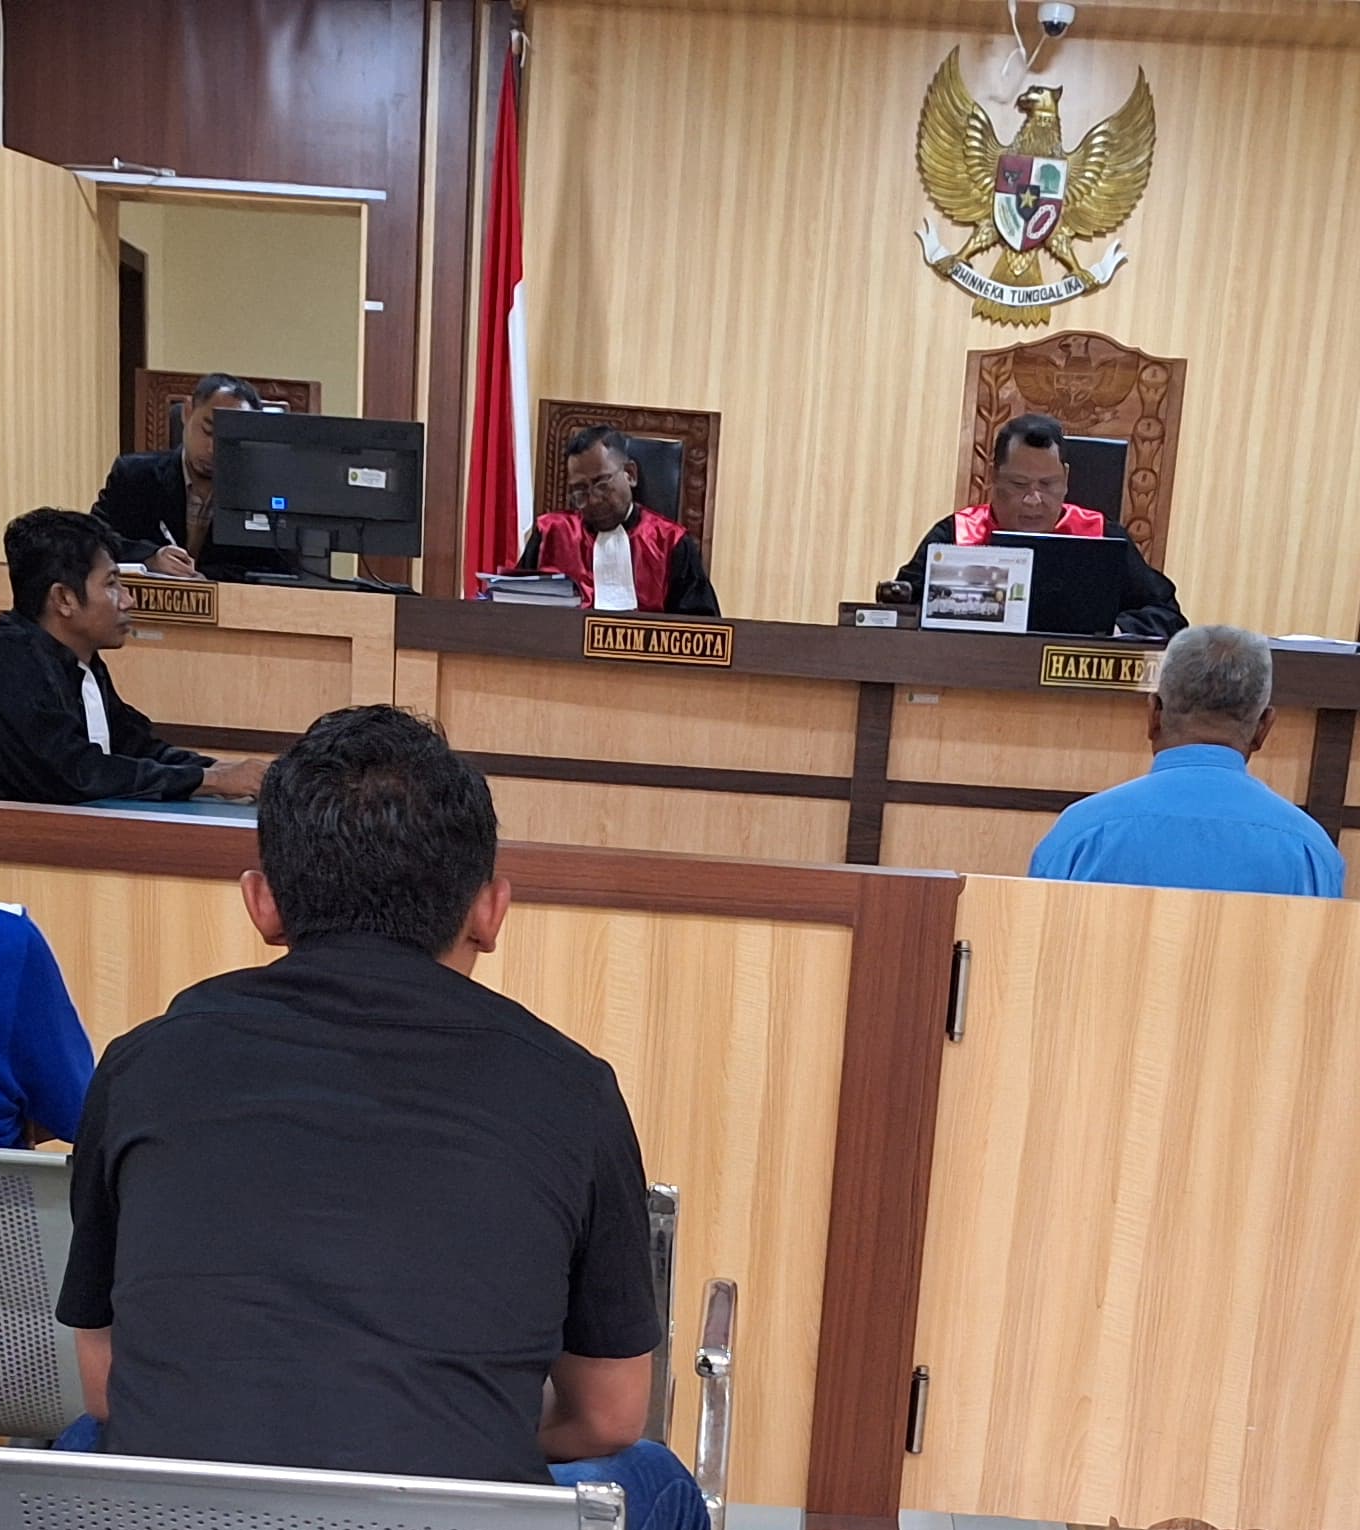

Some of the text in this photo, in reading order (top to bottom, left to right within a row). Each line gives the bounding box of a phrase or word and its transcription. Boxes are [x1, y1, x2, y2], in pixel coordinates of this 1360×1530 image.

[952, 266, 1083, 303] BHINNEKA TUNGGAL IKA
[141, 587, 210, 614] PENGGANTI
[593, 626, 723, 657] HAKIM ANGGOTA
[1050, 655, 1160, 682] HAKIM KET
